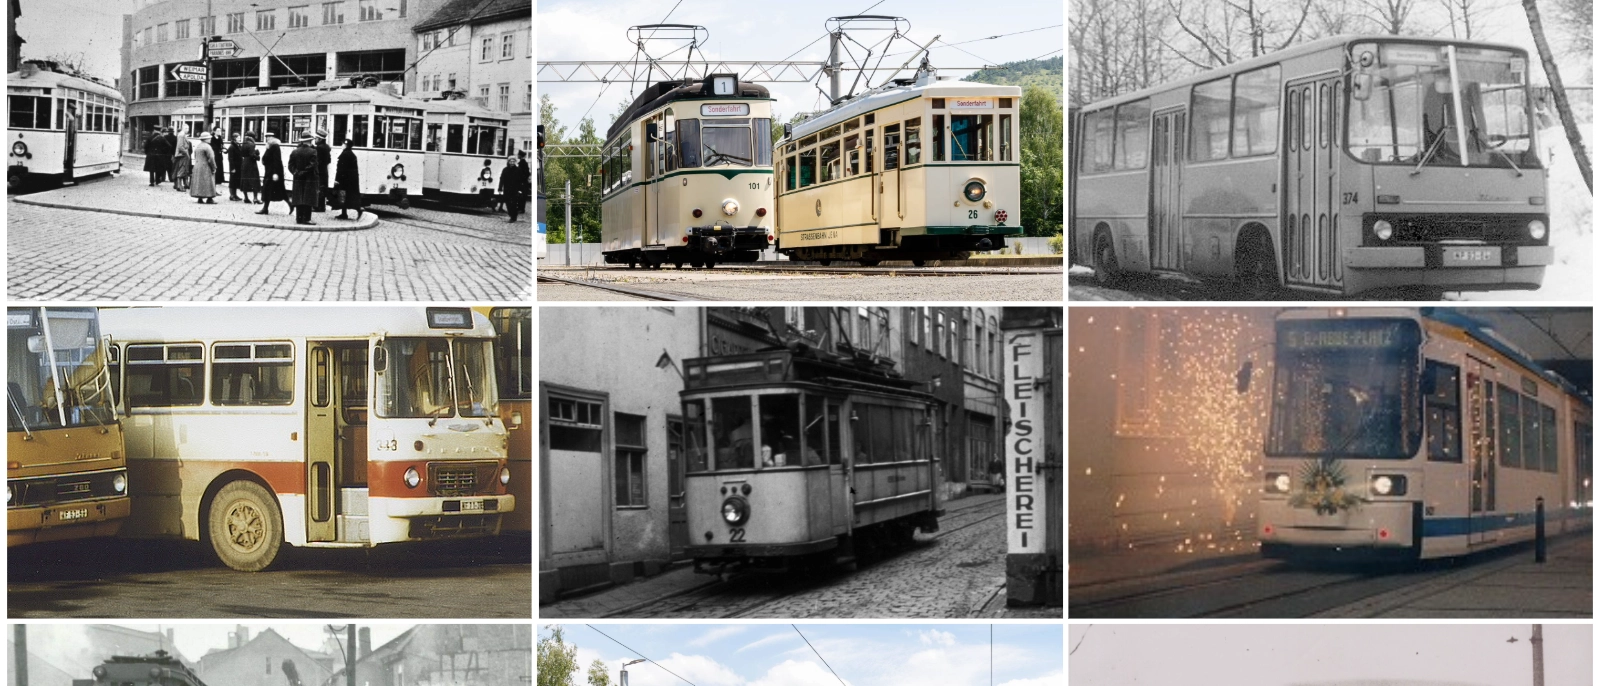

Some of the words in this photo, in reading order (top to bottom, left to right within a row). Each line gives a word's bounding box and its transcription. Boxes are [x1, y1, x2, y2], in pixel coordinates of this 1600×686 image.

[721, 81, 727, 93] 1
[707, 105, 742, 113] Sonderfahrt
[748, 182, 760, 190] 101
[1342, 191, 1359, 205] 374
[968, 209, 978, 219] 26
[1011, 340, 1036, 549] FLEISCHEREI
[728, 527, 747, 543] 22
